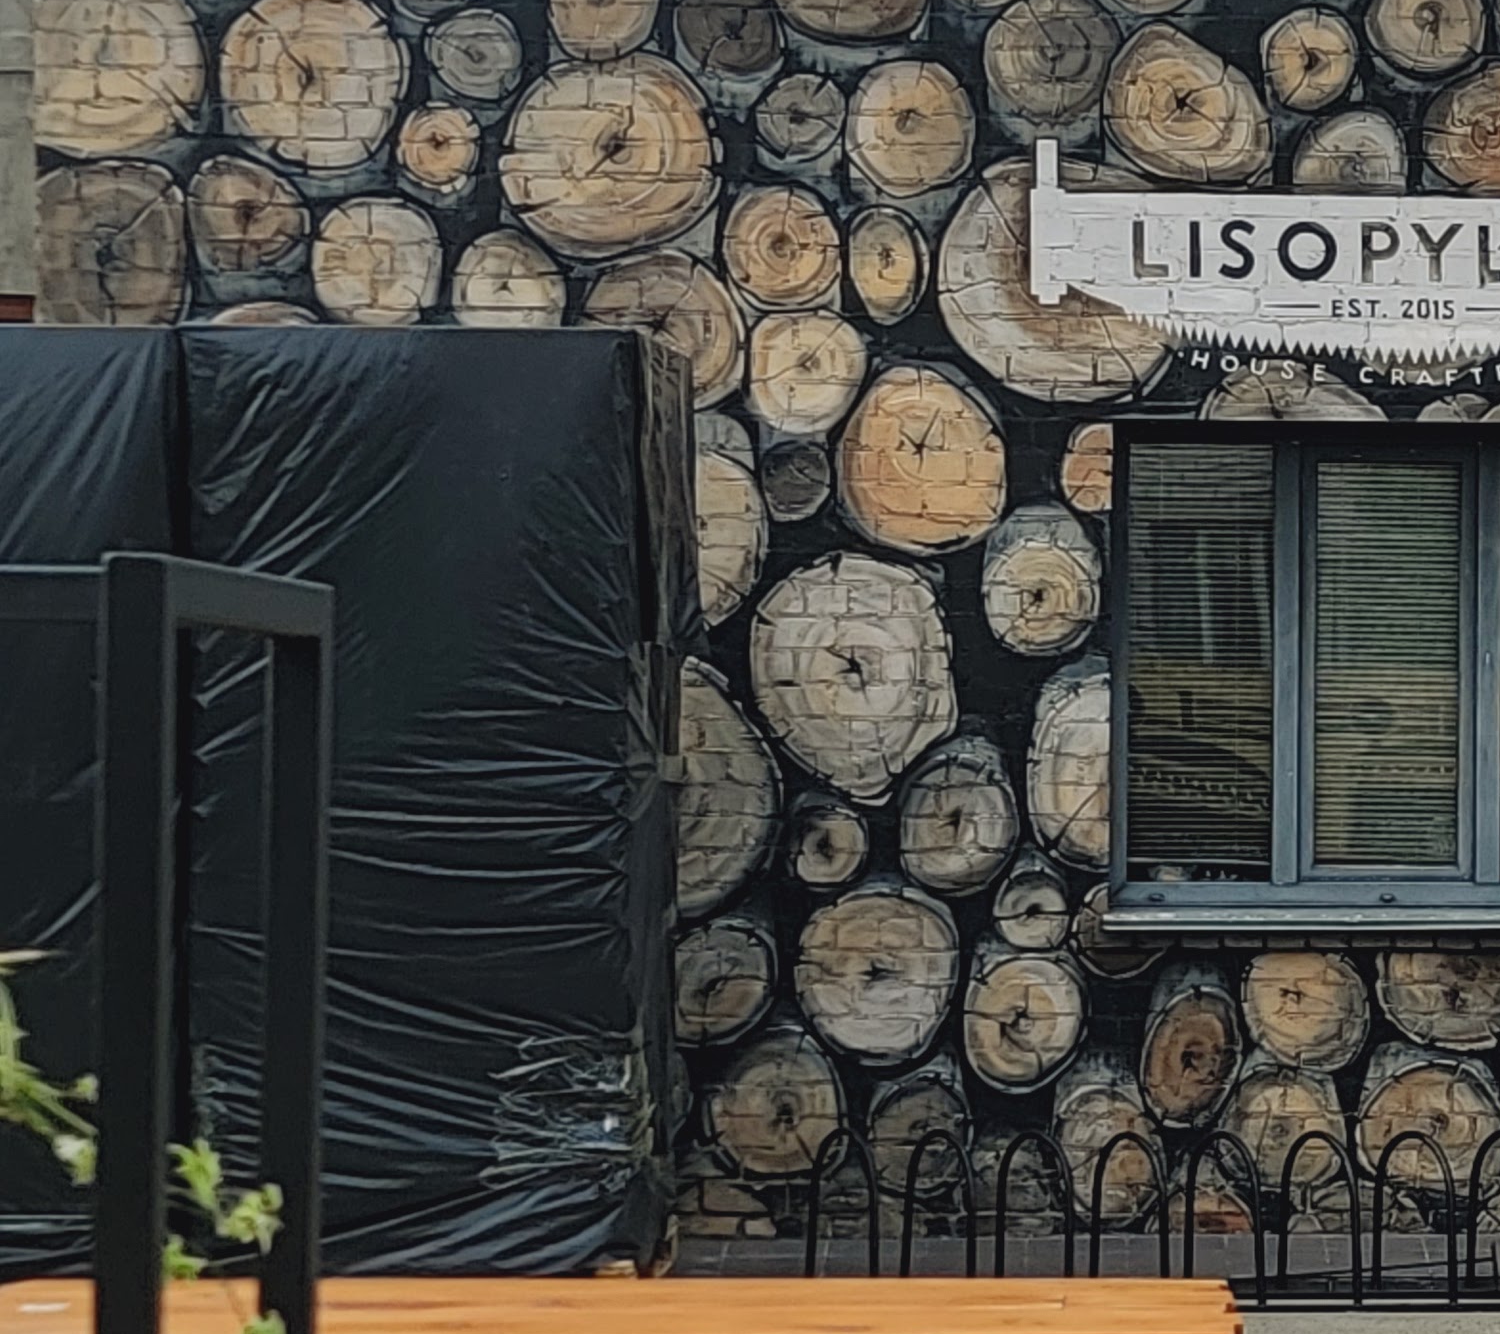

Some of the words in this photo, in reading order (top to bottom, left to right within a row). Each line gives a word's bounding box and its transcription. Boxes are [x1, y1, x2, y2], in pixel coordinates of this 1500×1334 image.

[1331, 298, 1388, 319] EST.
[1400, 299, 1455, 320] 2015
[1190, 349, 1327, 382] HOUSE
